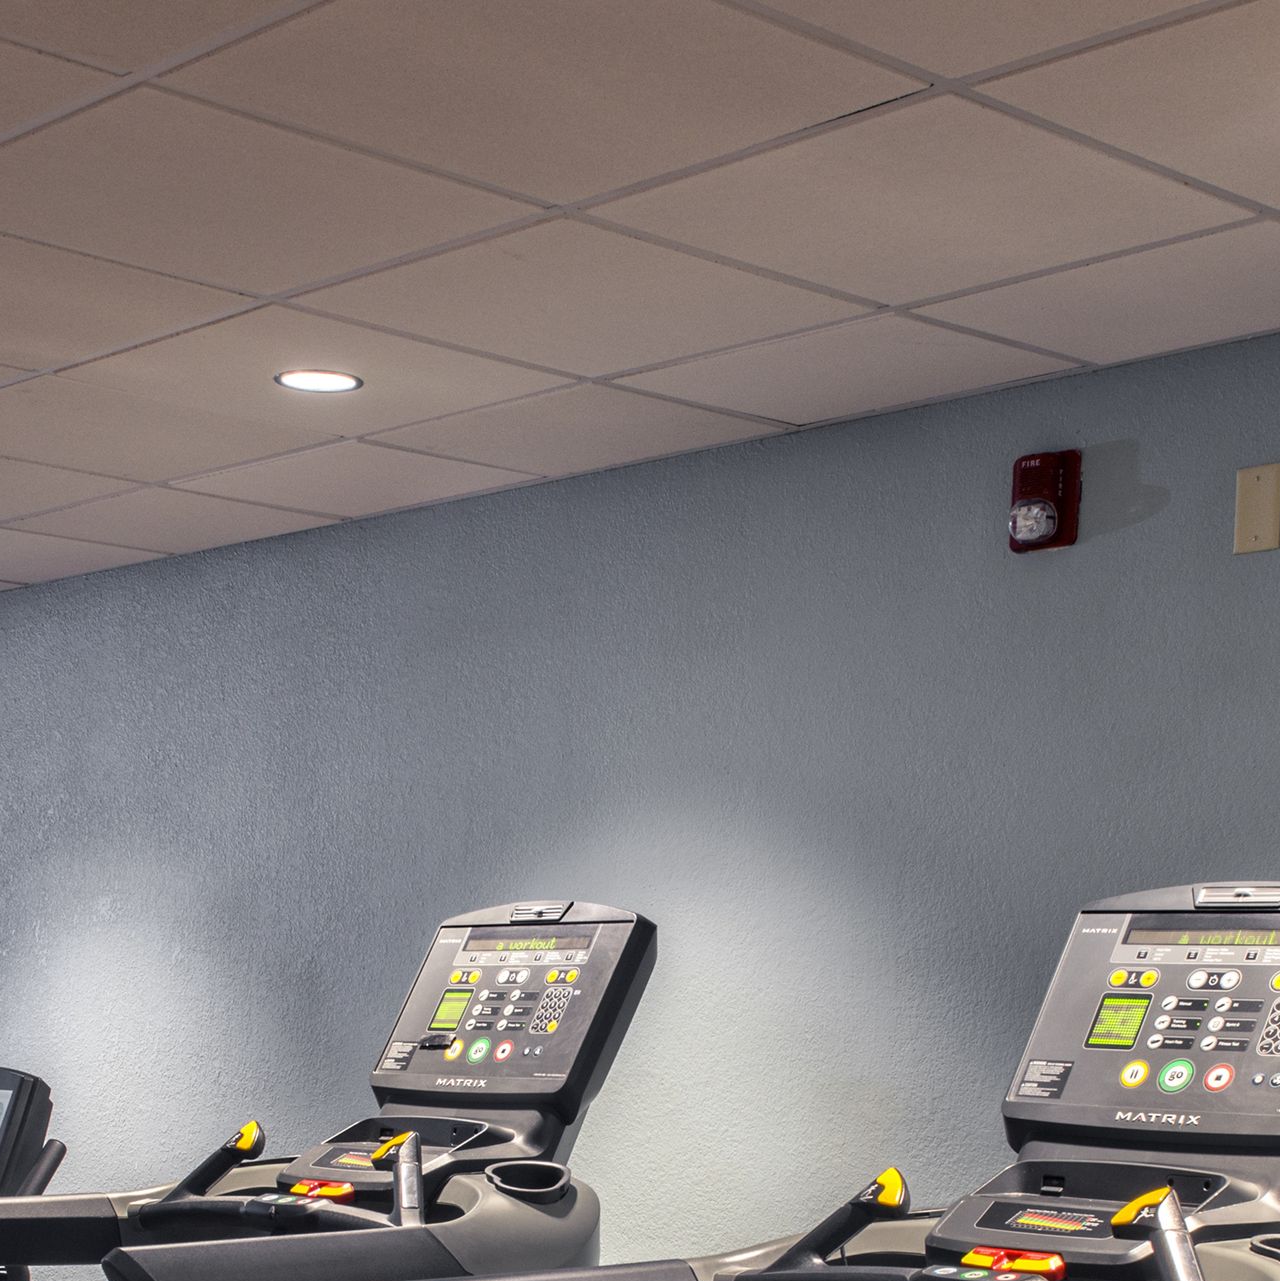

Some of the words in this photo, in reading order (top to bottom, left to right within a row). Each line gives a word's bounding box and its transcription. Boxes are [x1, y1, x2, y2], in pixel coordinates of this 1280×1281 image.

[1022, 459, 1040, 468] FIRE
[495, 941, 503, 950] a
[508, 938, 558, 950] workout
[1200, 930, 1277, 945] workout
[1167, 1067, 1184, 1084] go
[435, 1077, 488, 1089] MATRIX
[1114, 1110, 1201, 1127] MATRIX
